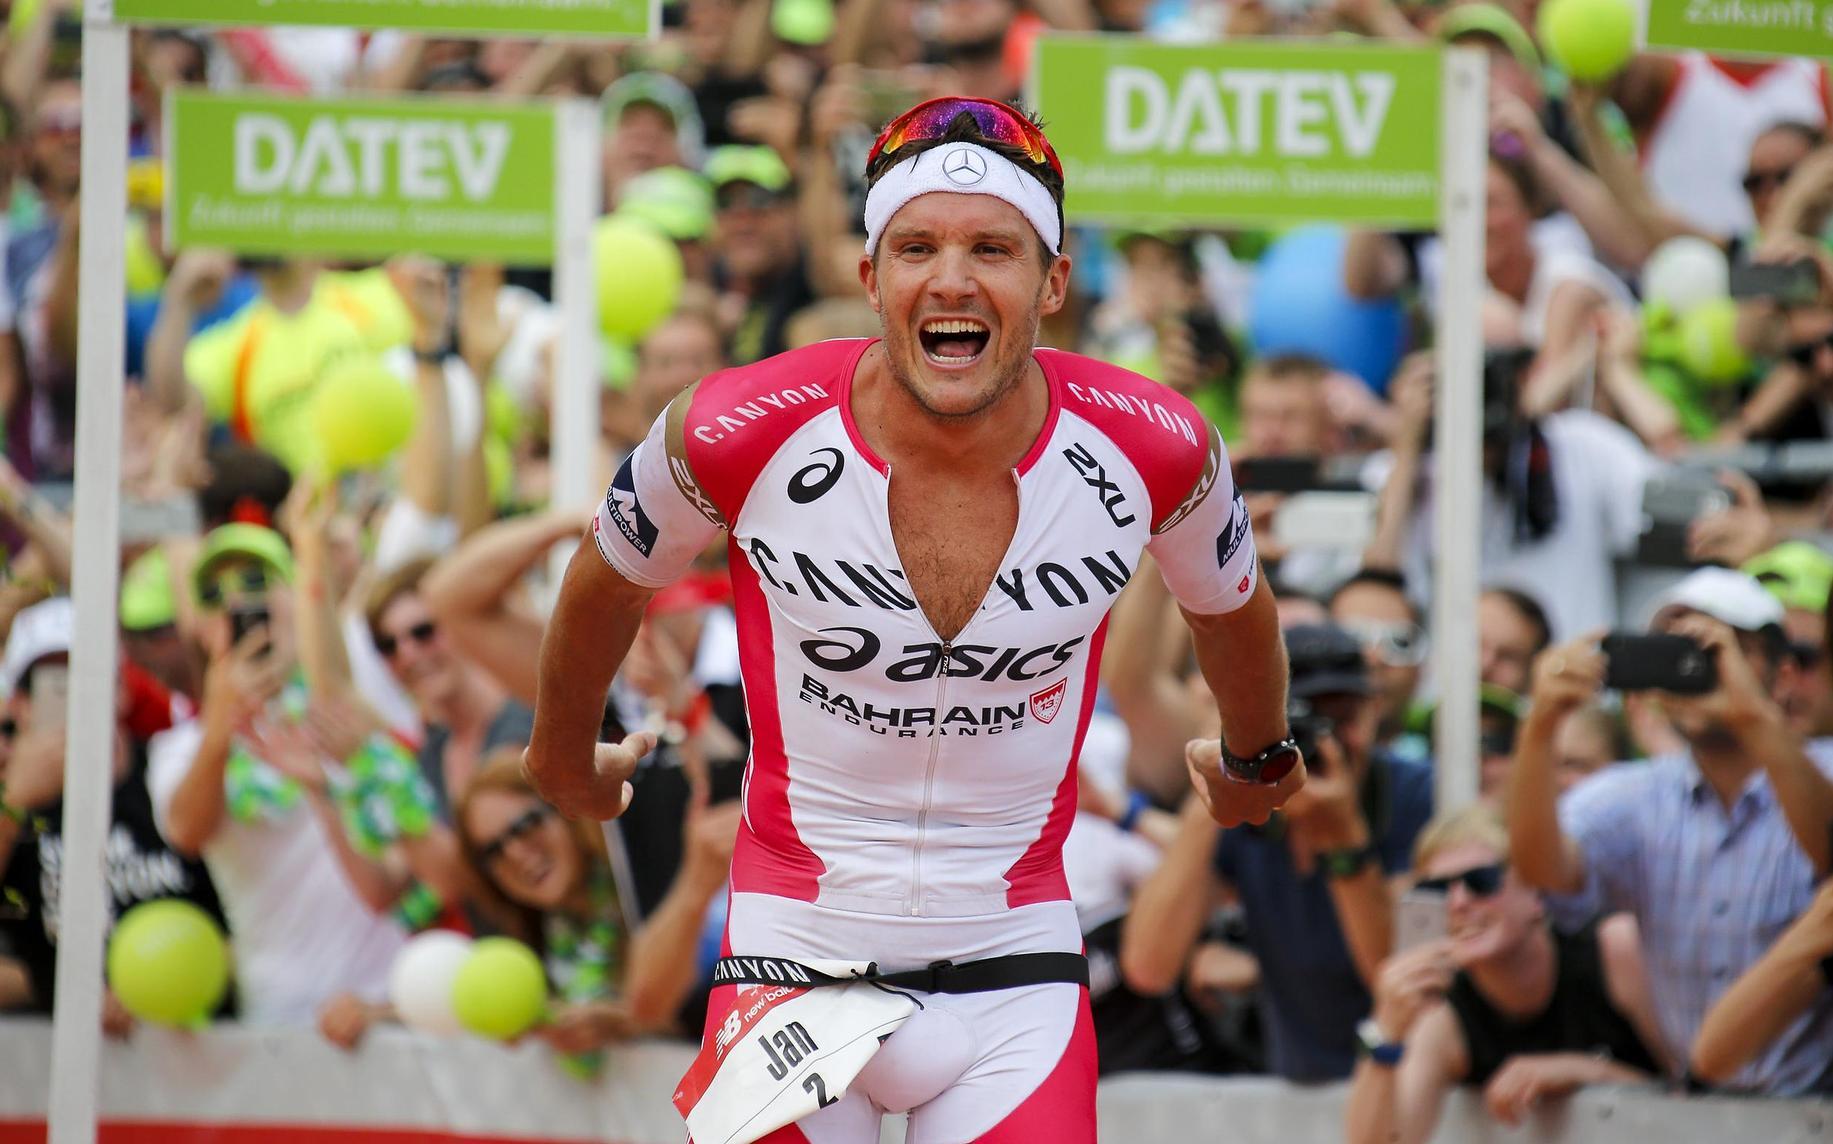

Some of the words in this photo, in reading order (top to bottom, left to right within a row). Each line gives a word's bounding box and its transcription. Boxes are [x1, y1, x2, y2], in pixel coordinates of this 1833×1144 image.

[1106, 65, 1396, 158] DATEV
[234, 112, 513, 200] DATEV
[693, 382, 829, 445] CANYON
[1067, 381, 1198, 448] CANYON
[1062, 442, 1136, 528] 2XU
[1159, 448, 1218, 534] 2XU
[885, 634, 1086, 683] asics
[798, 690, 1024, 738] ENDURANCE
[801, 672, 1026, 730] BAHRAIN
[744, 997, 765, 1023] new
[757, 1020, 819, 1081] Jan
[801, 1072, 840, 1109] 2
